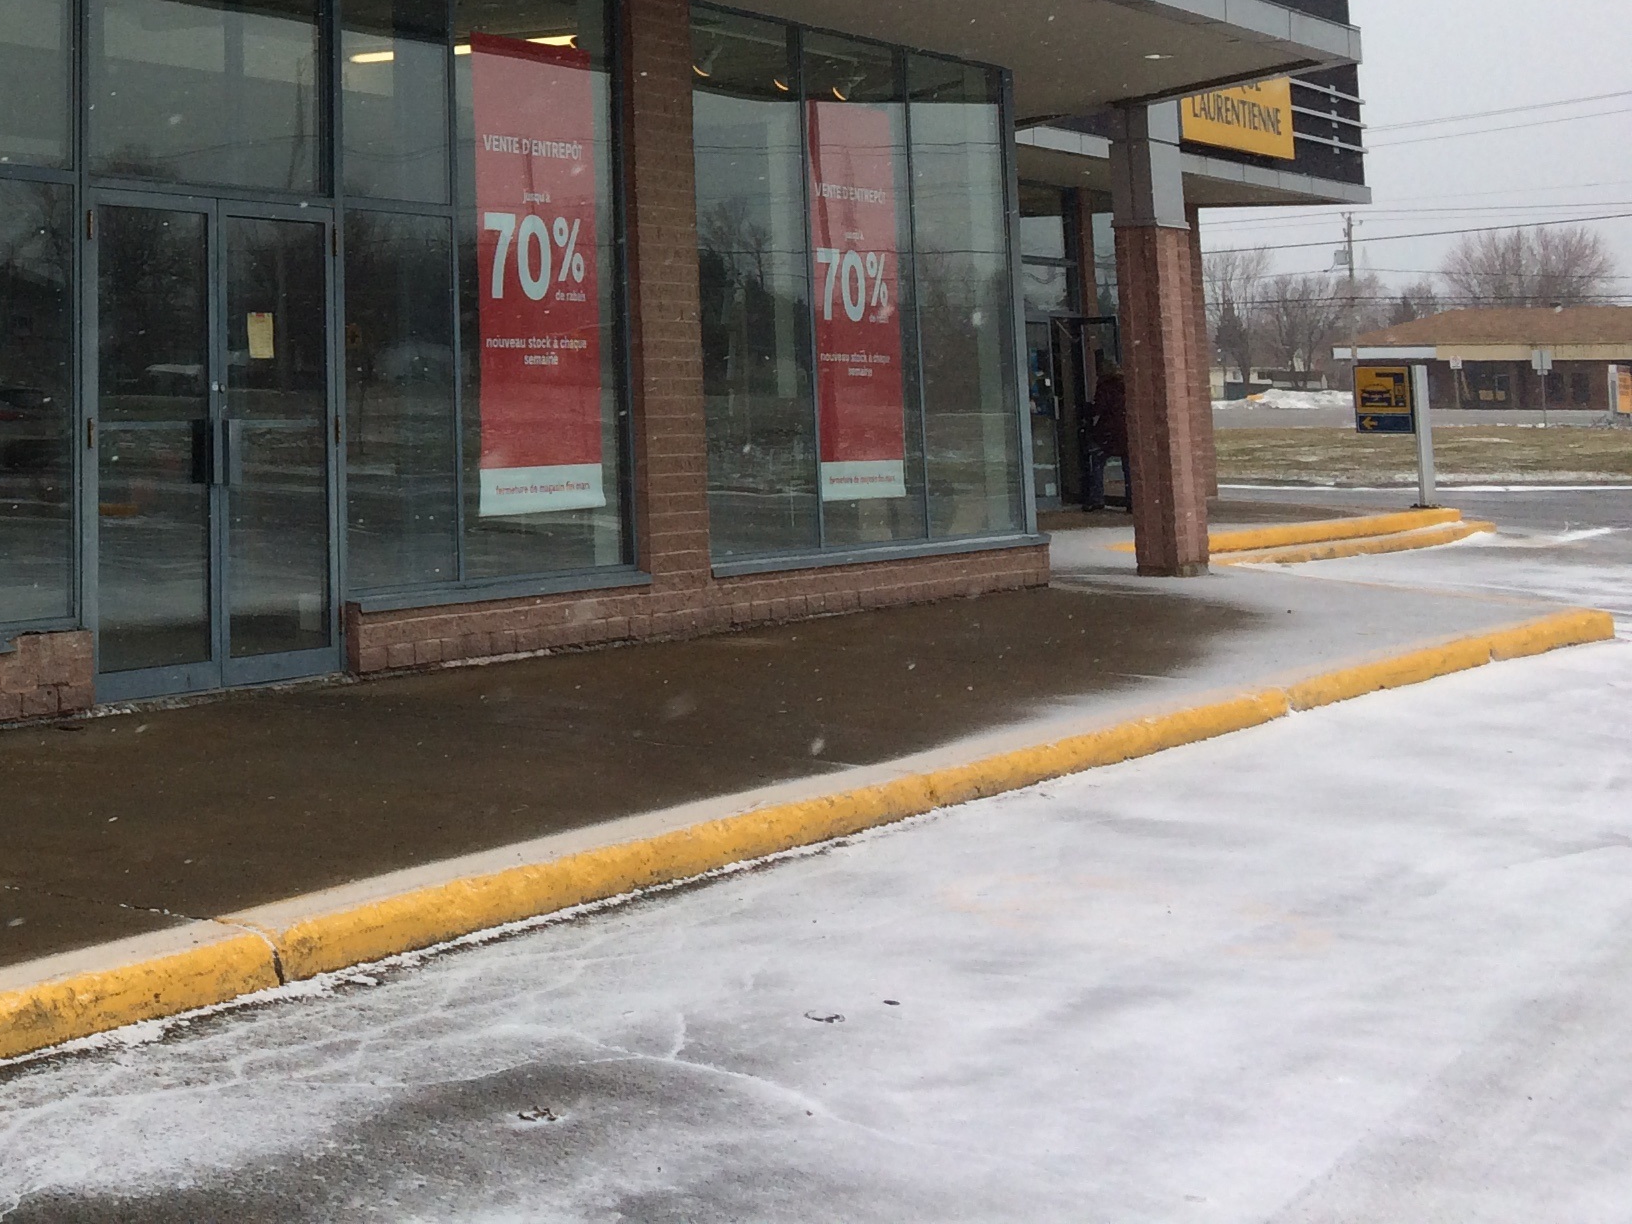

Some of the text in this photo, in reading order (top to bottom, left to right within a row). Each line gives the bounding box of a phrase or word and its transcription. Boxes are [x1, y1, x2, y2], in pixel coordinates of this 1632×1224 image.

[1191, 93, 1282, 136] LAURENTIENNE
[483, 134, 583, 161] VENTE D'ENTREPÔT
[484, 212, 585, 301] 70%
[816, 247, 888, 322] 70%
[485, 336, 526, 350] nouveau
[528, 335, 551, 350] stock
[560, 335, 587, 351] chaque
[524, 352, 559, 366] semaine
